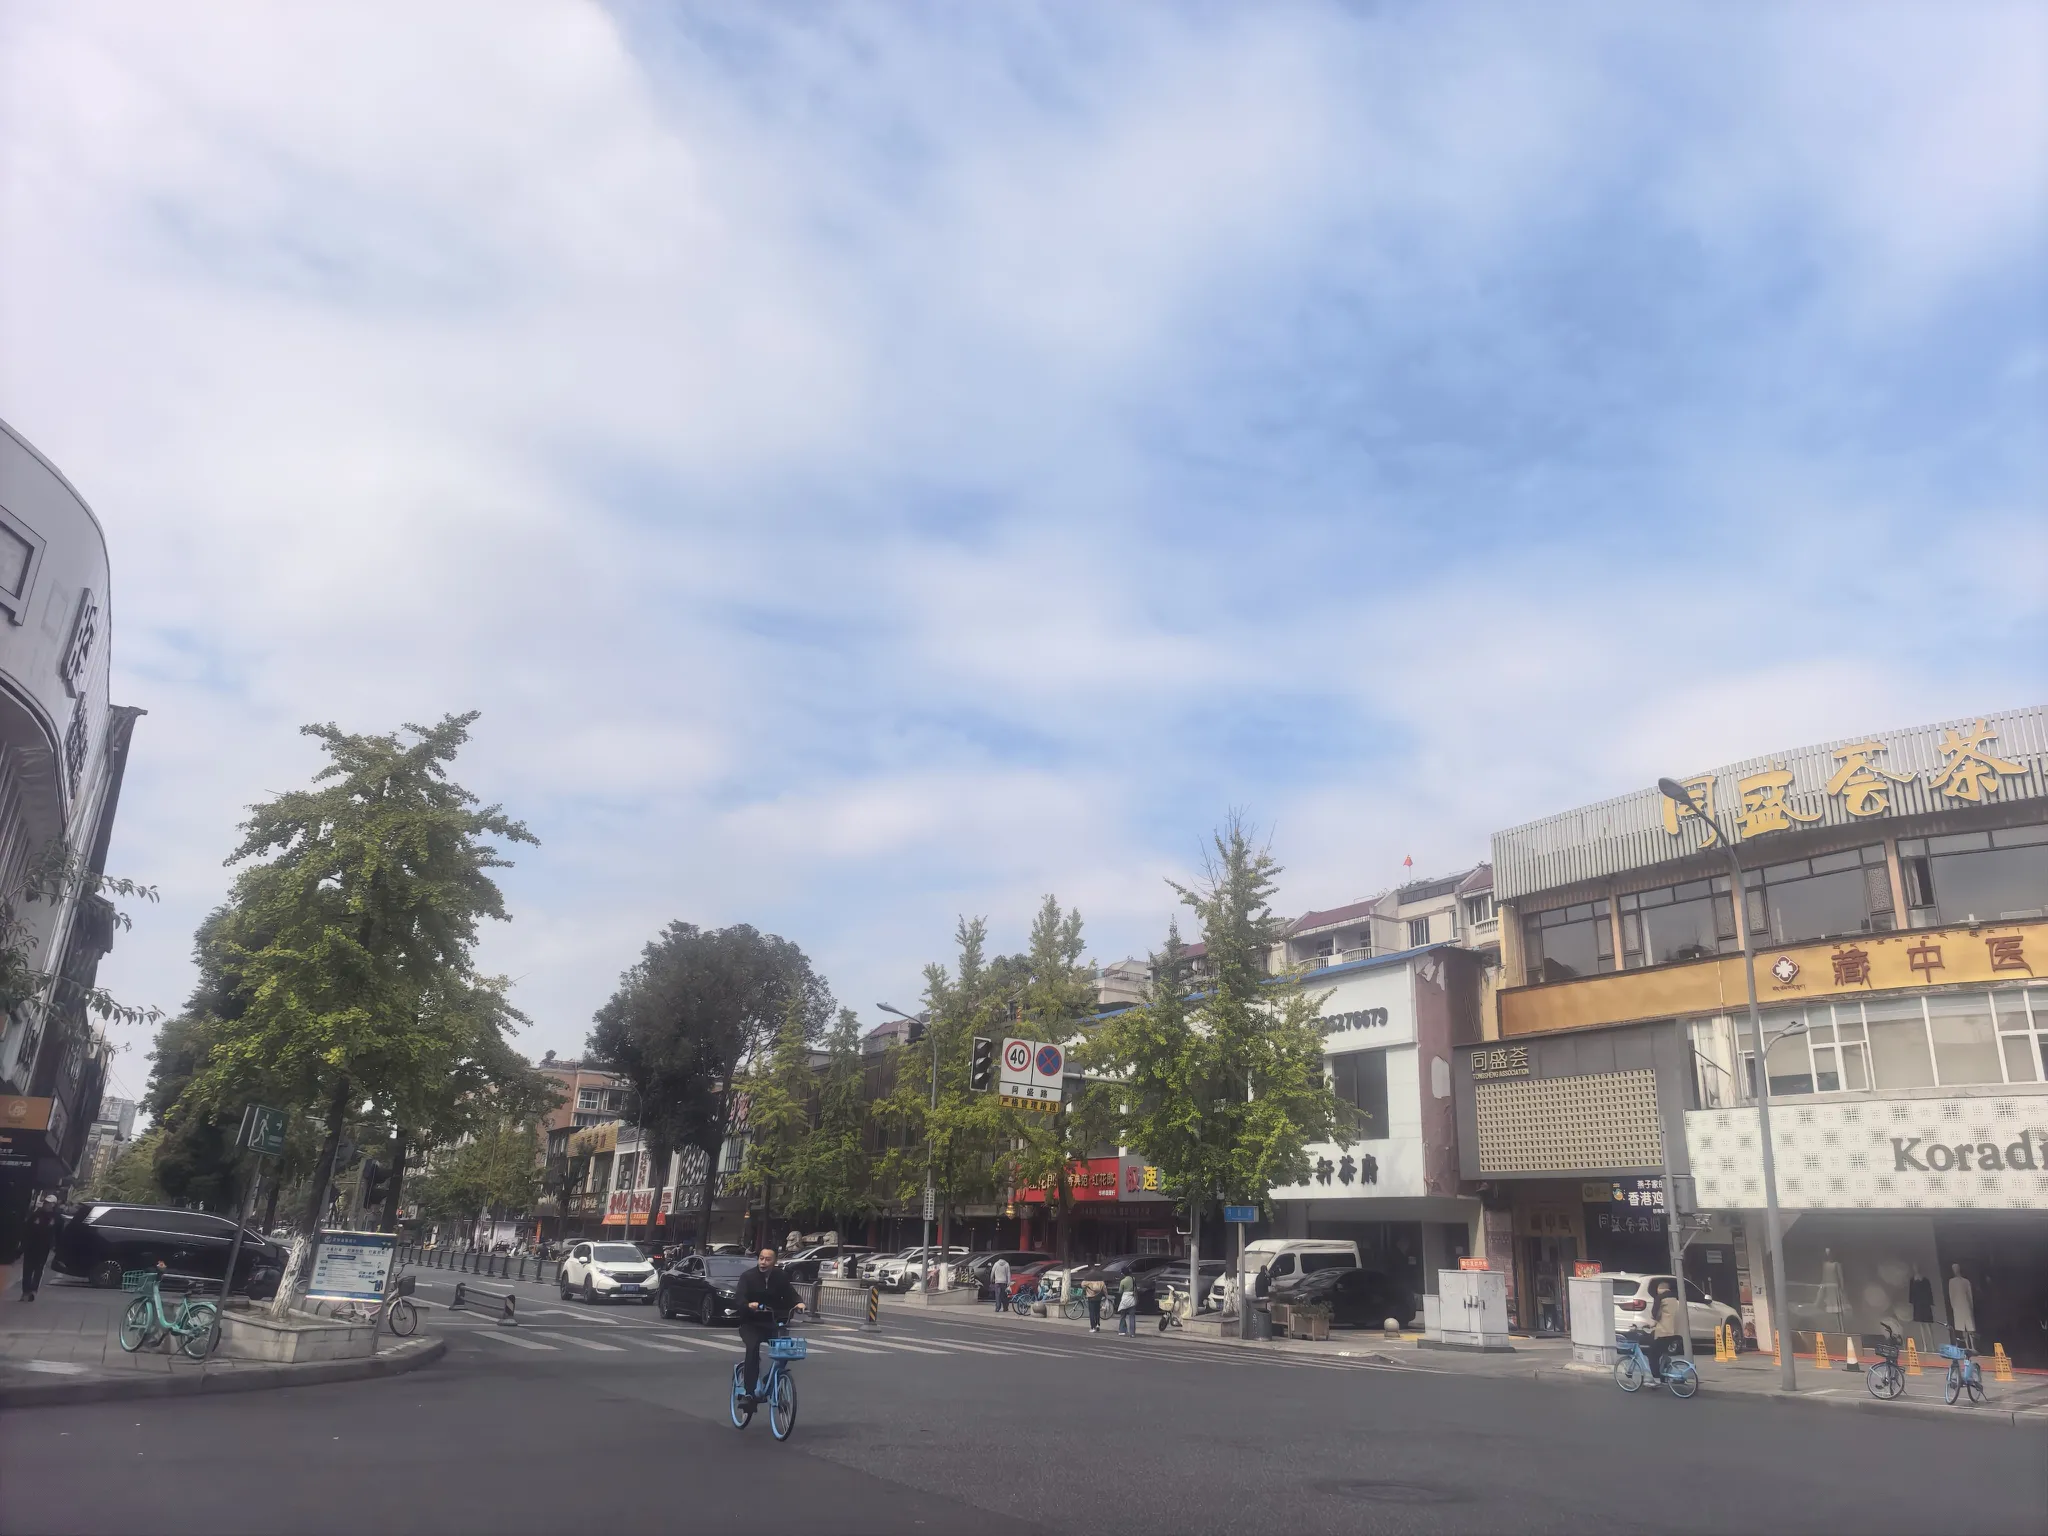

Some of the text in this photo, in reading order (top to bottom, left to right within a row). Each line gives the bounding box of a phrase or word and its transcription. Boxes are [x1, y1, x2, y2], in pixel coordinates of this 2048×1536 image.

[1831, 935, 2034, 989] 藏中医
[1010, 1048, 1025, 1065] 40
[1471, 1046, 1528, 1071] 同盛荟
[1499, 1068, 1529, 1077] ASSOCIATION
[1011, 1085, 1047, 1099] 同盛路
